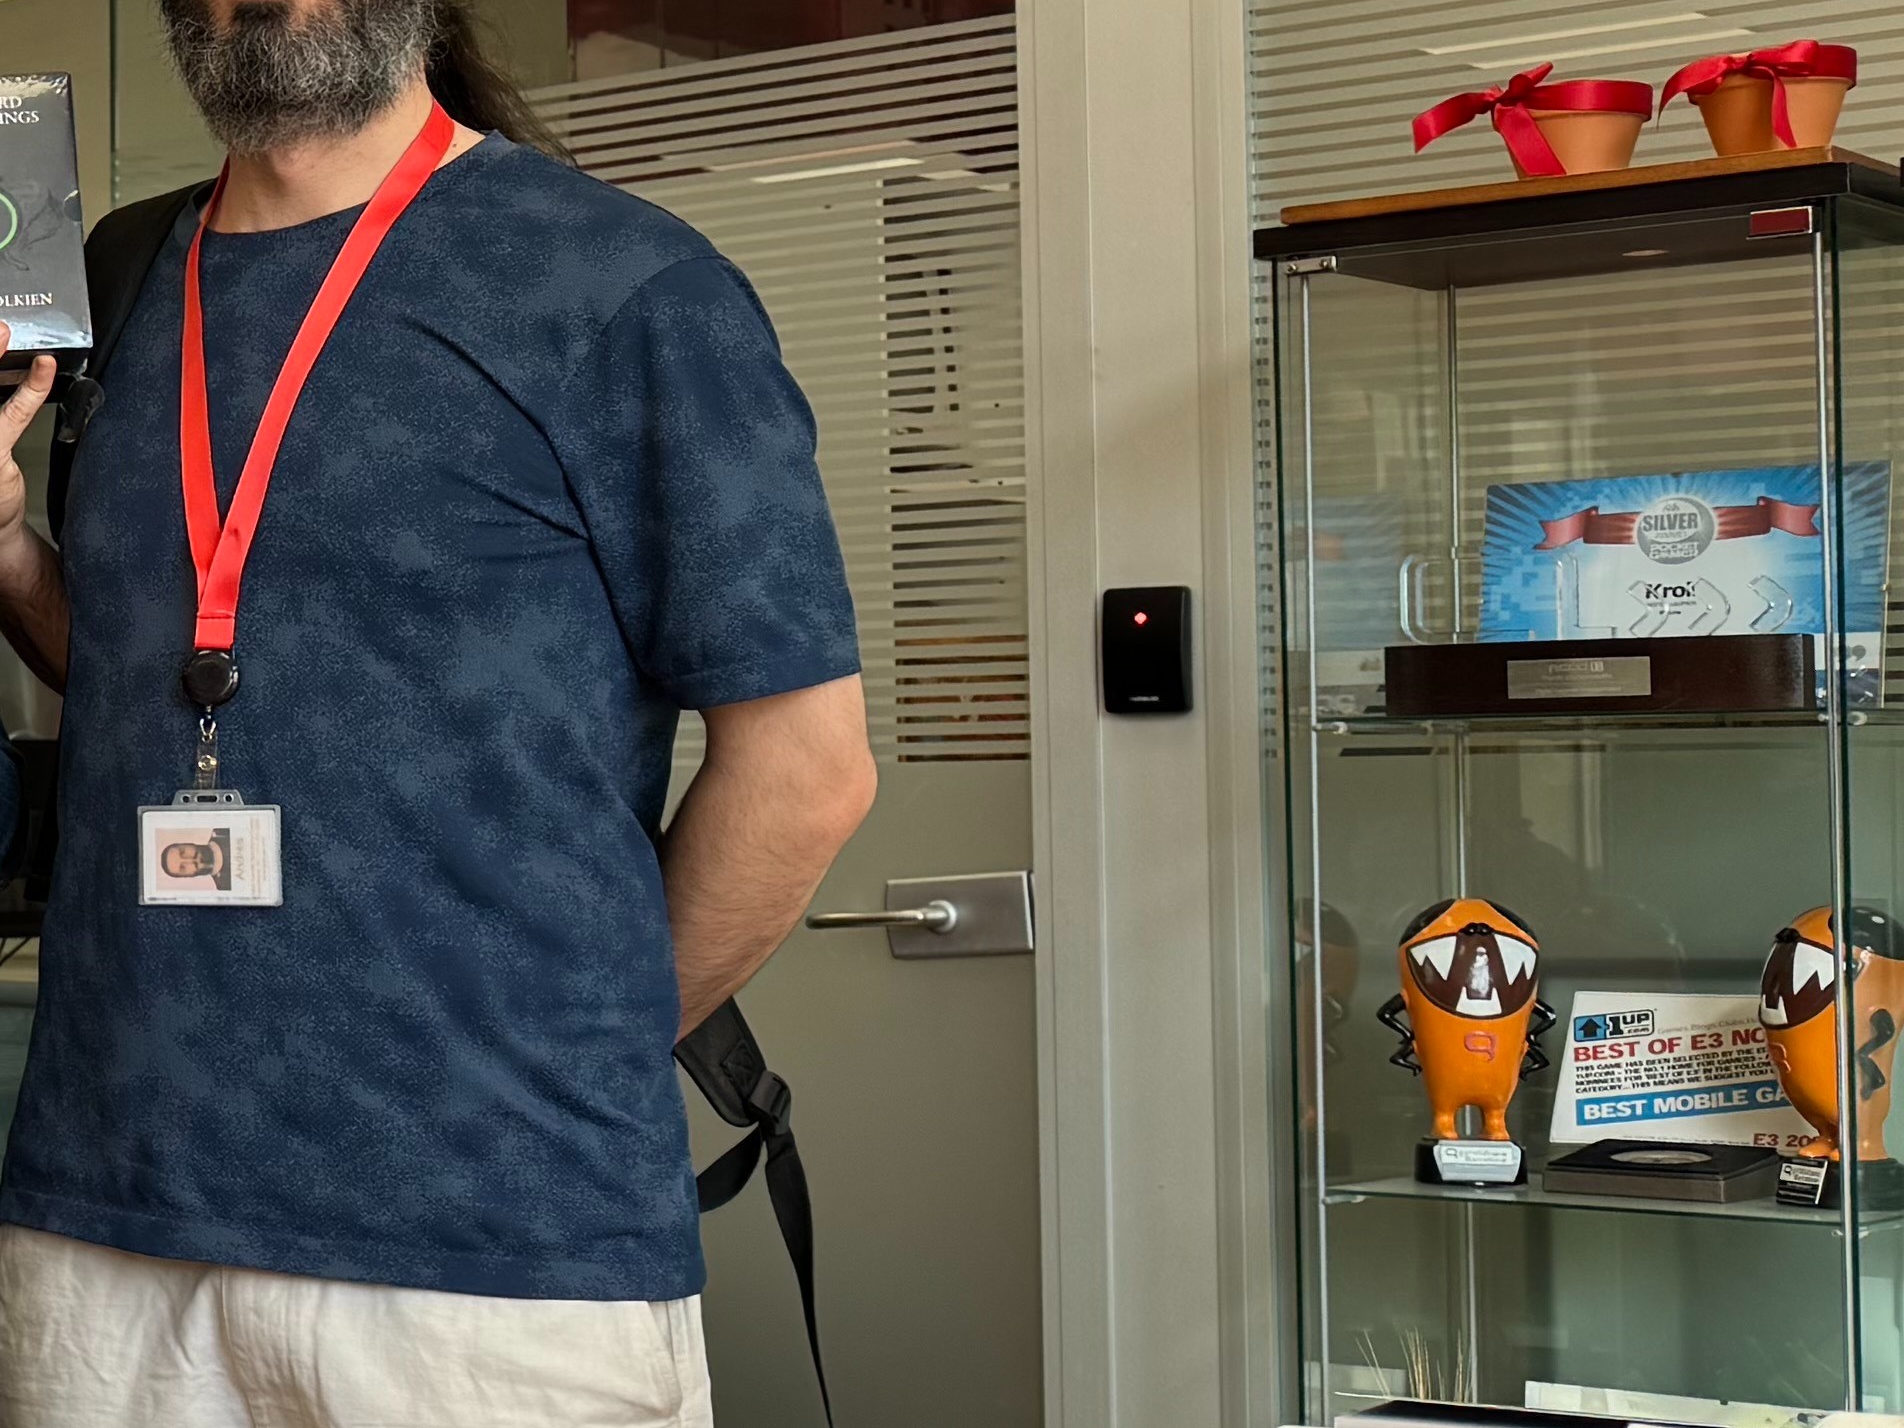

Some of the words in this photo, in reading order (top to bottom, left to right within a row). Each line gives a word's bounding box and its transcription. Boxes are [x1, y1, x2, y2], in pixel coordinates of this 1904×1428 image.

[1642, 513, 1698, 532] SILVER
[1573, 1041, 1640, 1062] BEST
[1648, 1037, 1682, 1055] OF
[1691, 1032, 1723, 1050] E3
[1583, 1099, 1647, 1120] BEST
[1653, 1087, 1749, 1115] MOBILE
[1753, 1133, 1779, 1147] E3
[1785, 1134, 1820, 1148] 20
